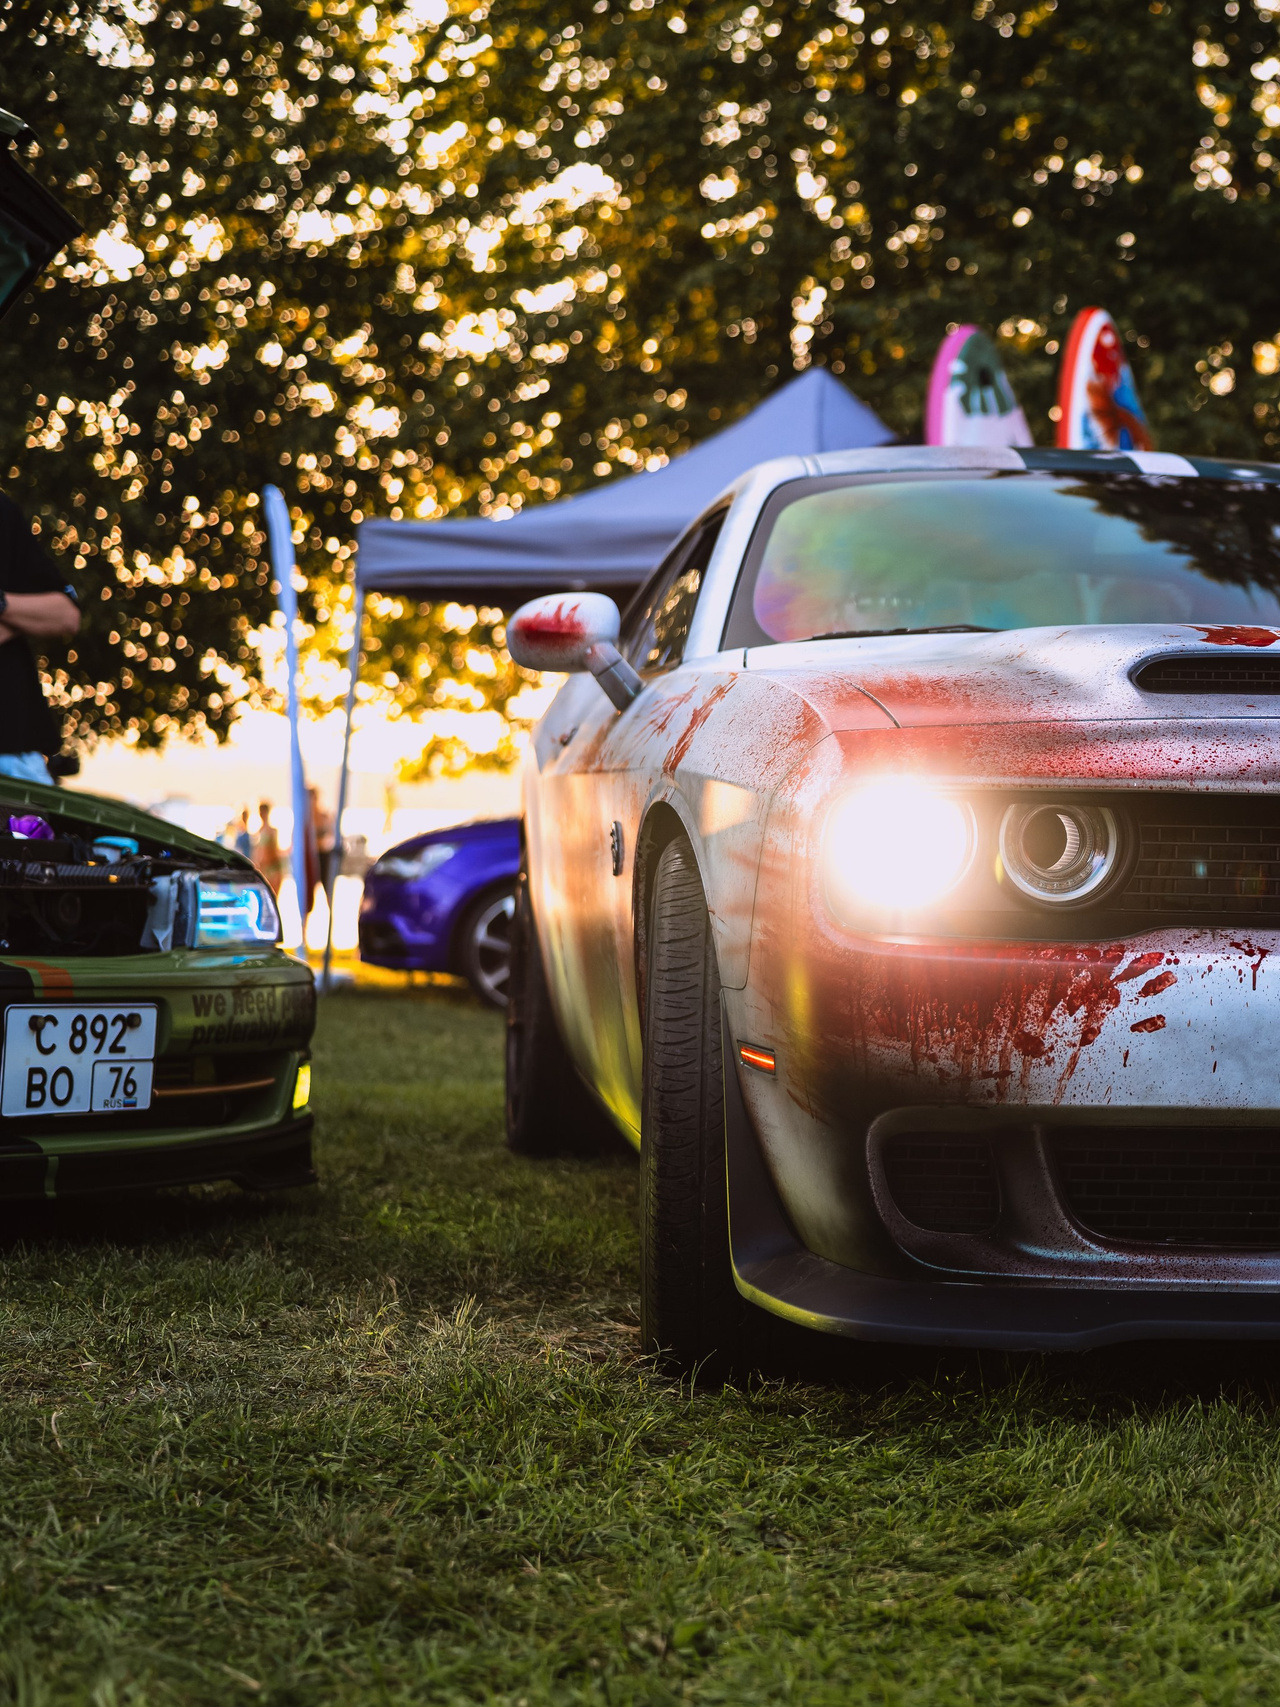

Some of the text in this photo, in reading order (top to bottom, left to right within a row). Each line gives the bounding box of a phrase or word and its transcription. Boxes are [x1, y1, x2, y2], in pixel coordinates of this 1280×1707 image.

[192, 994, 227, 1018] we
[68, 1014, 128, 1055] 892
[108, 1066, 138, 1099] 76
[103, 1098, 123, 1109] RUS
